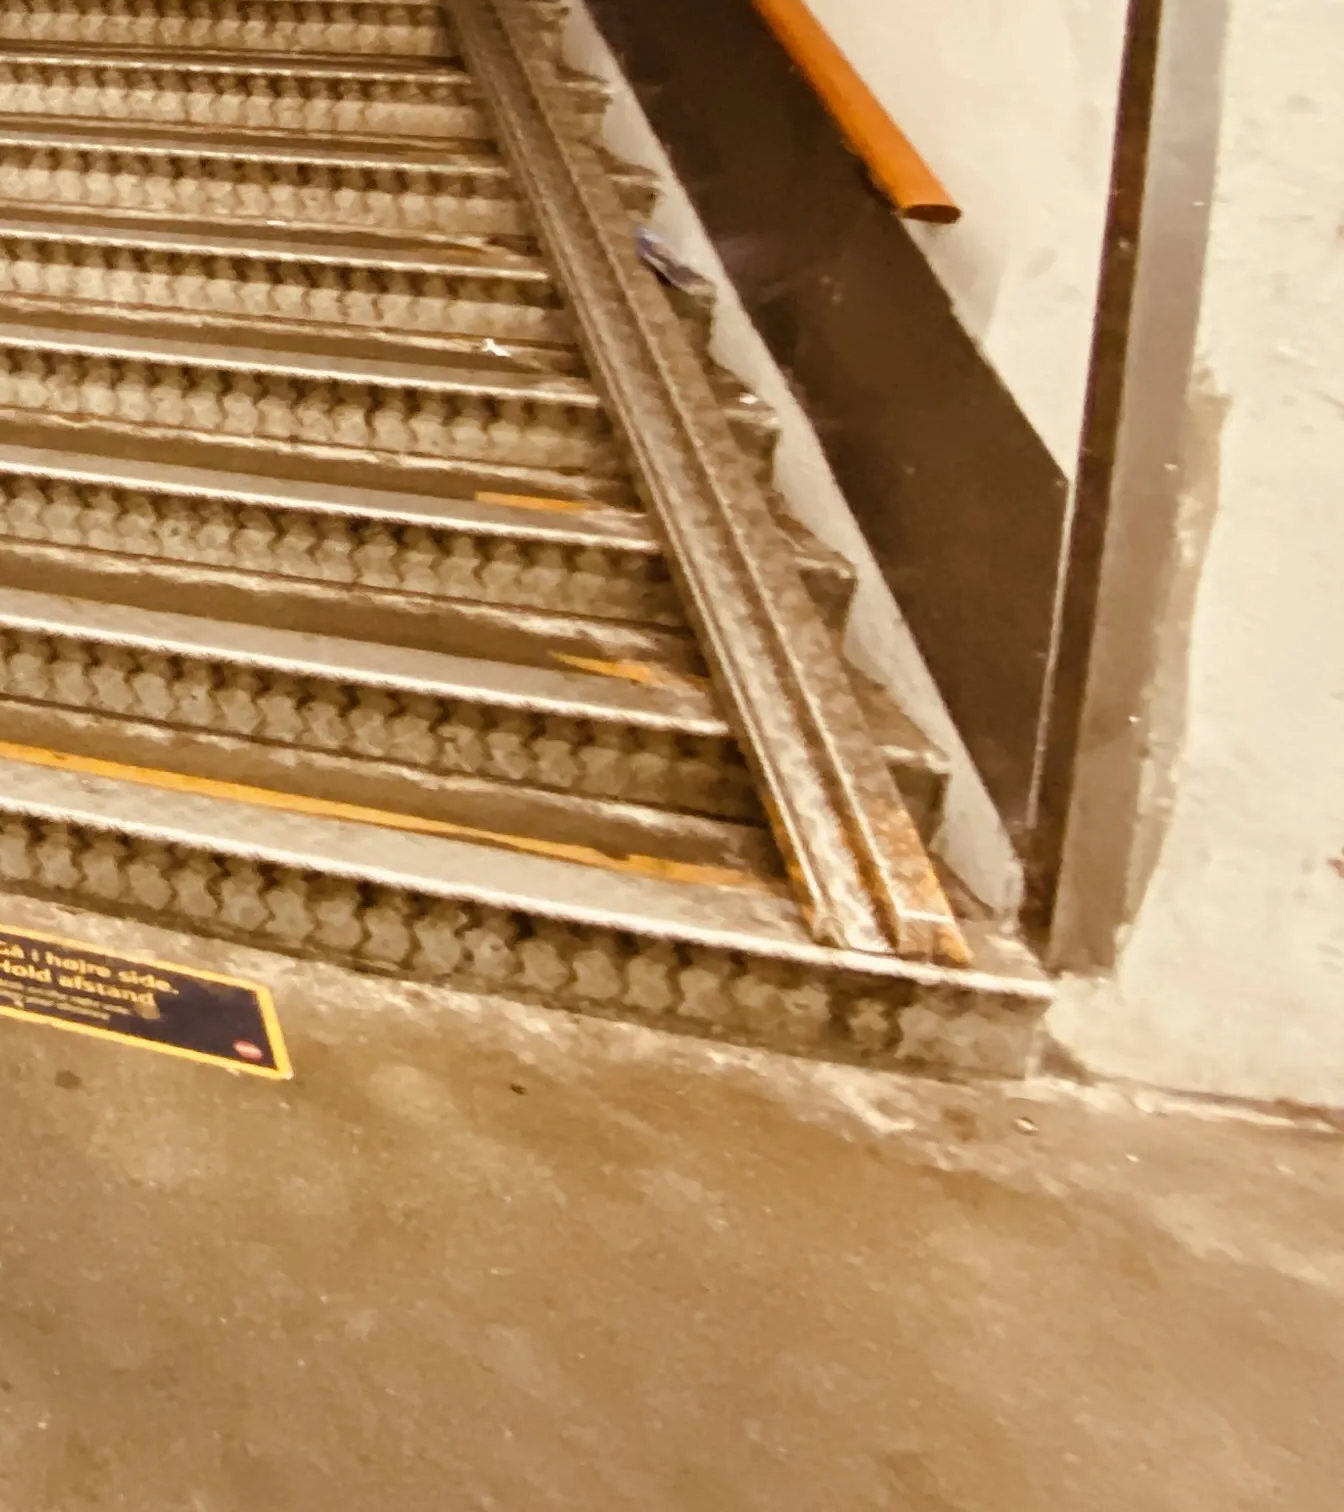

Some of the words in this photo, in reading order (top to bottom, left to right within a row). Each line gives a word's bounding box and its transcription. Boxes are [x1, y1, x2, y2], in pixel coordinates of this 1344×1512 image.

[31, 948, 40, 962] i
[45, 951, 112, 978] højre
[117, 970, 179, 995] side.
[57, 975, 155, 1006] afstand
